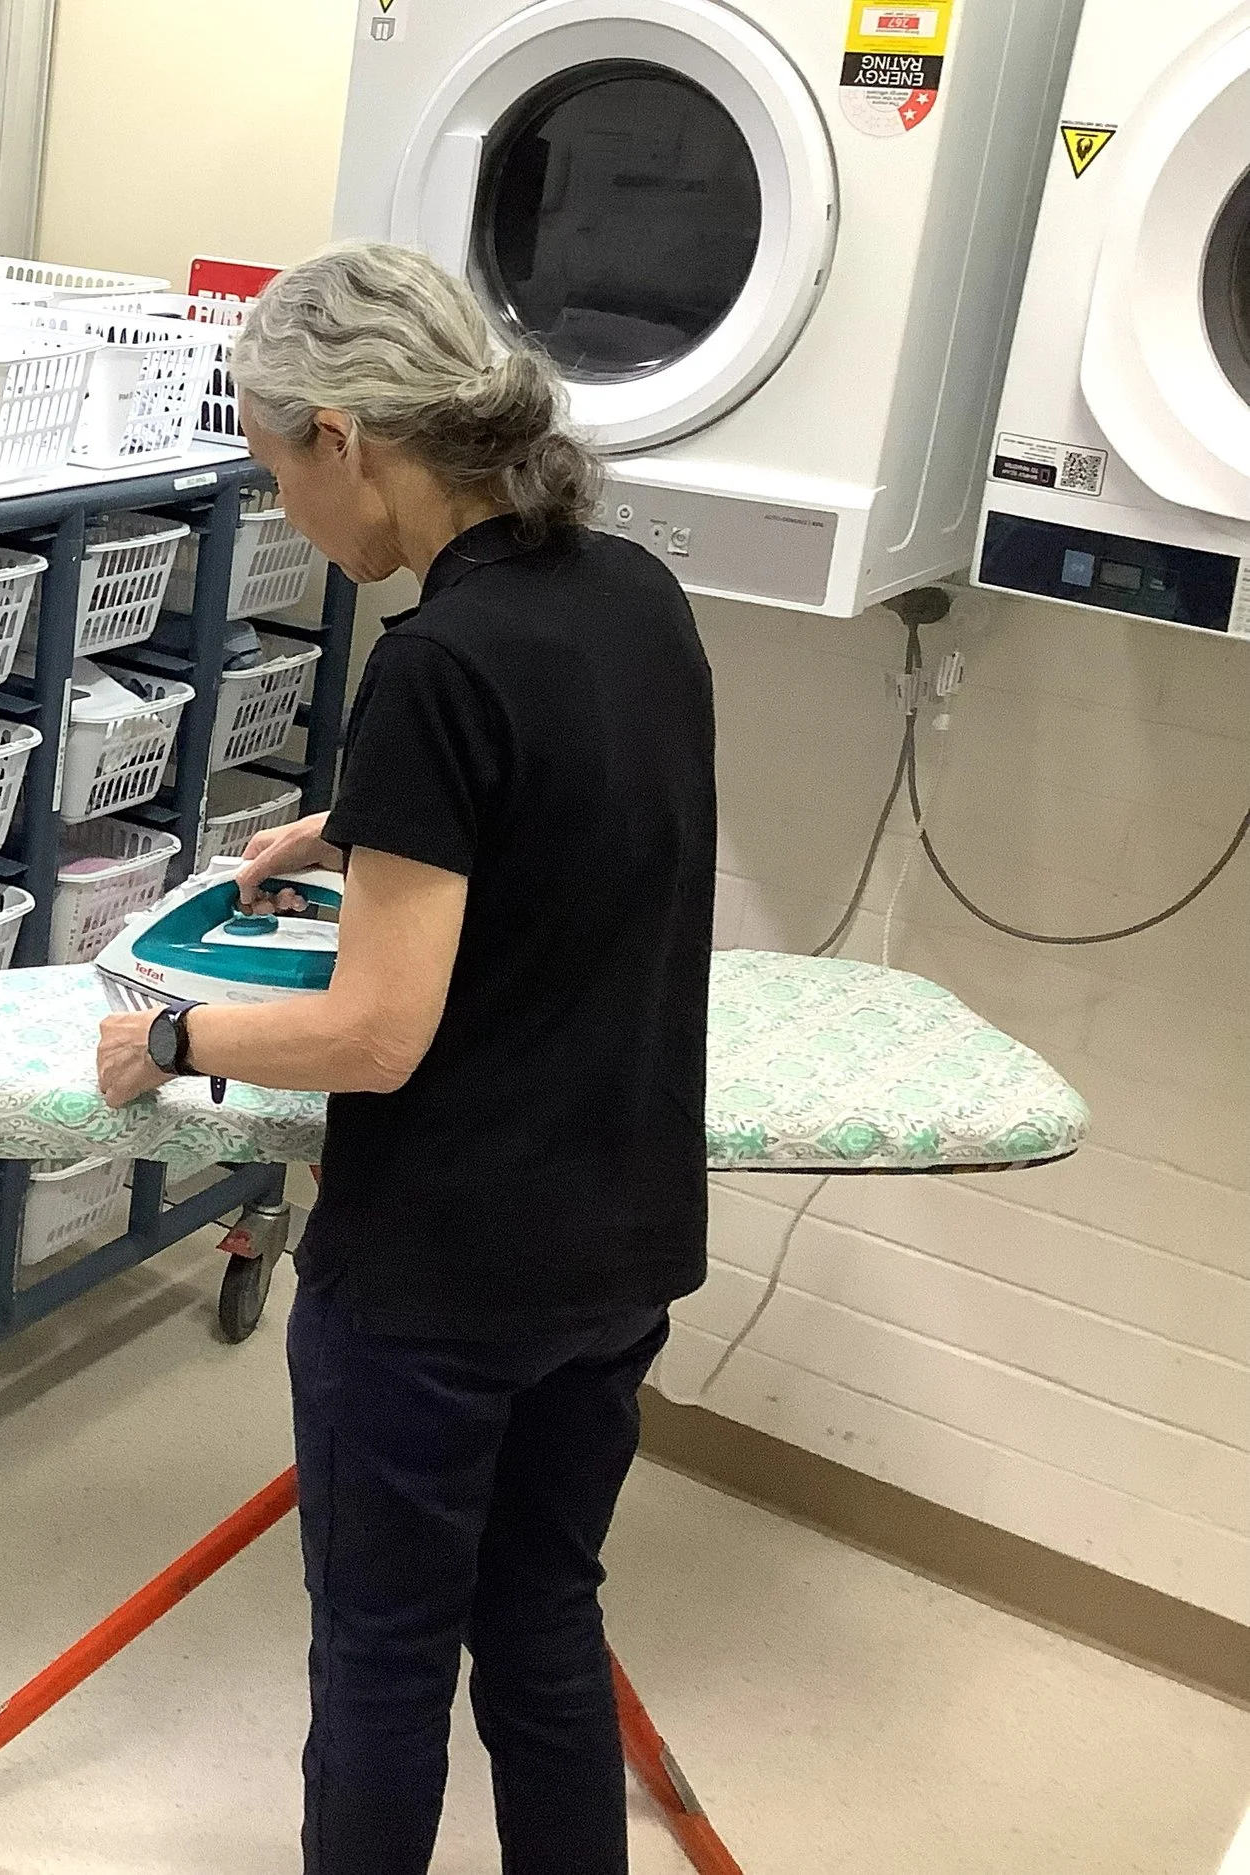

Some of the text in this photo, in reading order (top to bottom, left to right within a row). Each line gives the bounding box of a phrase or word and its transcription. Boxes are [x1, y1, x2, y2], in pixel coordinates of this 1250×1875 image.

[887, 18, 909, 28] 267
[861, 55, 923, 72] RATING
[854, 70, 924, 86] ENERGY
[135, 961, 165, 983] Tefal
